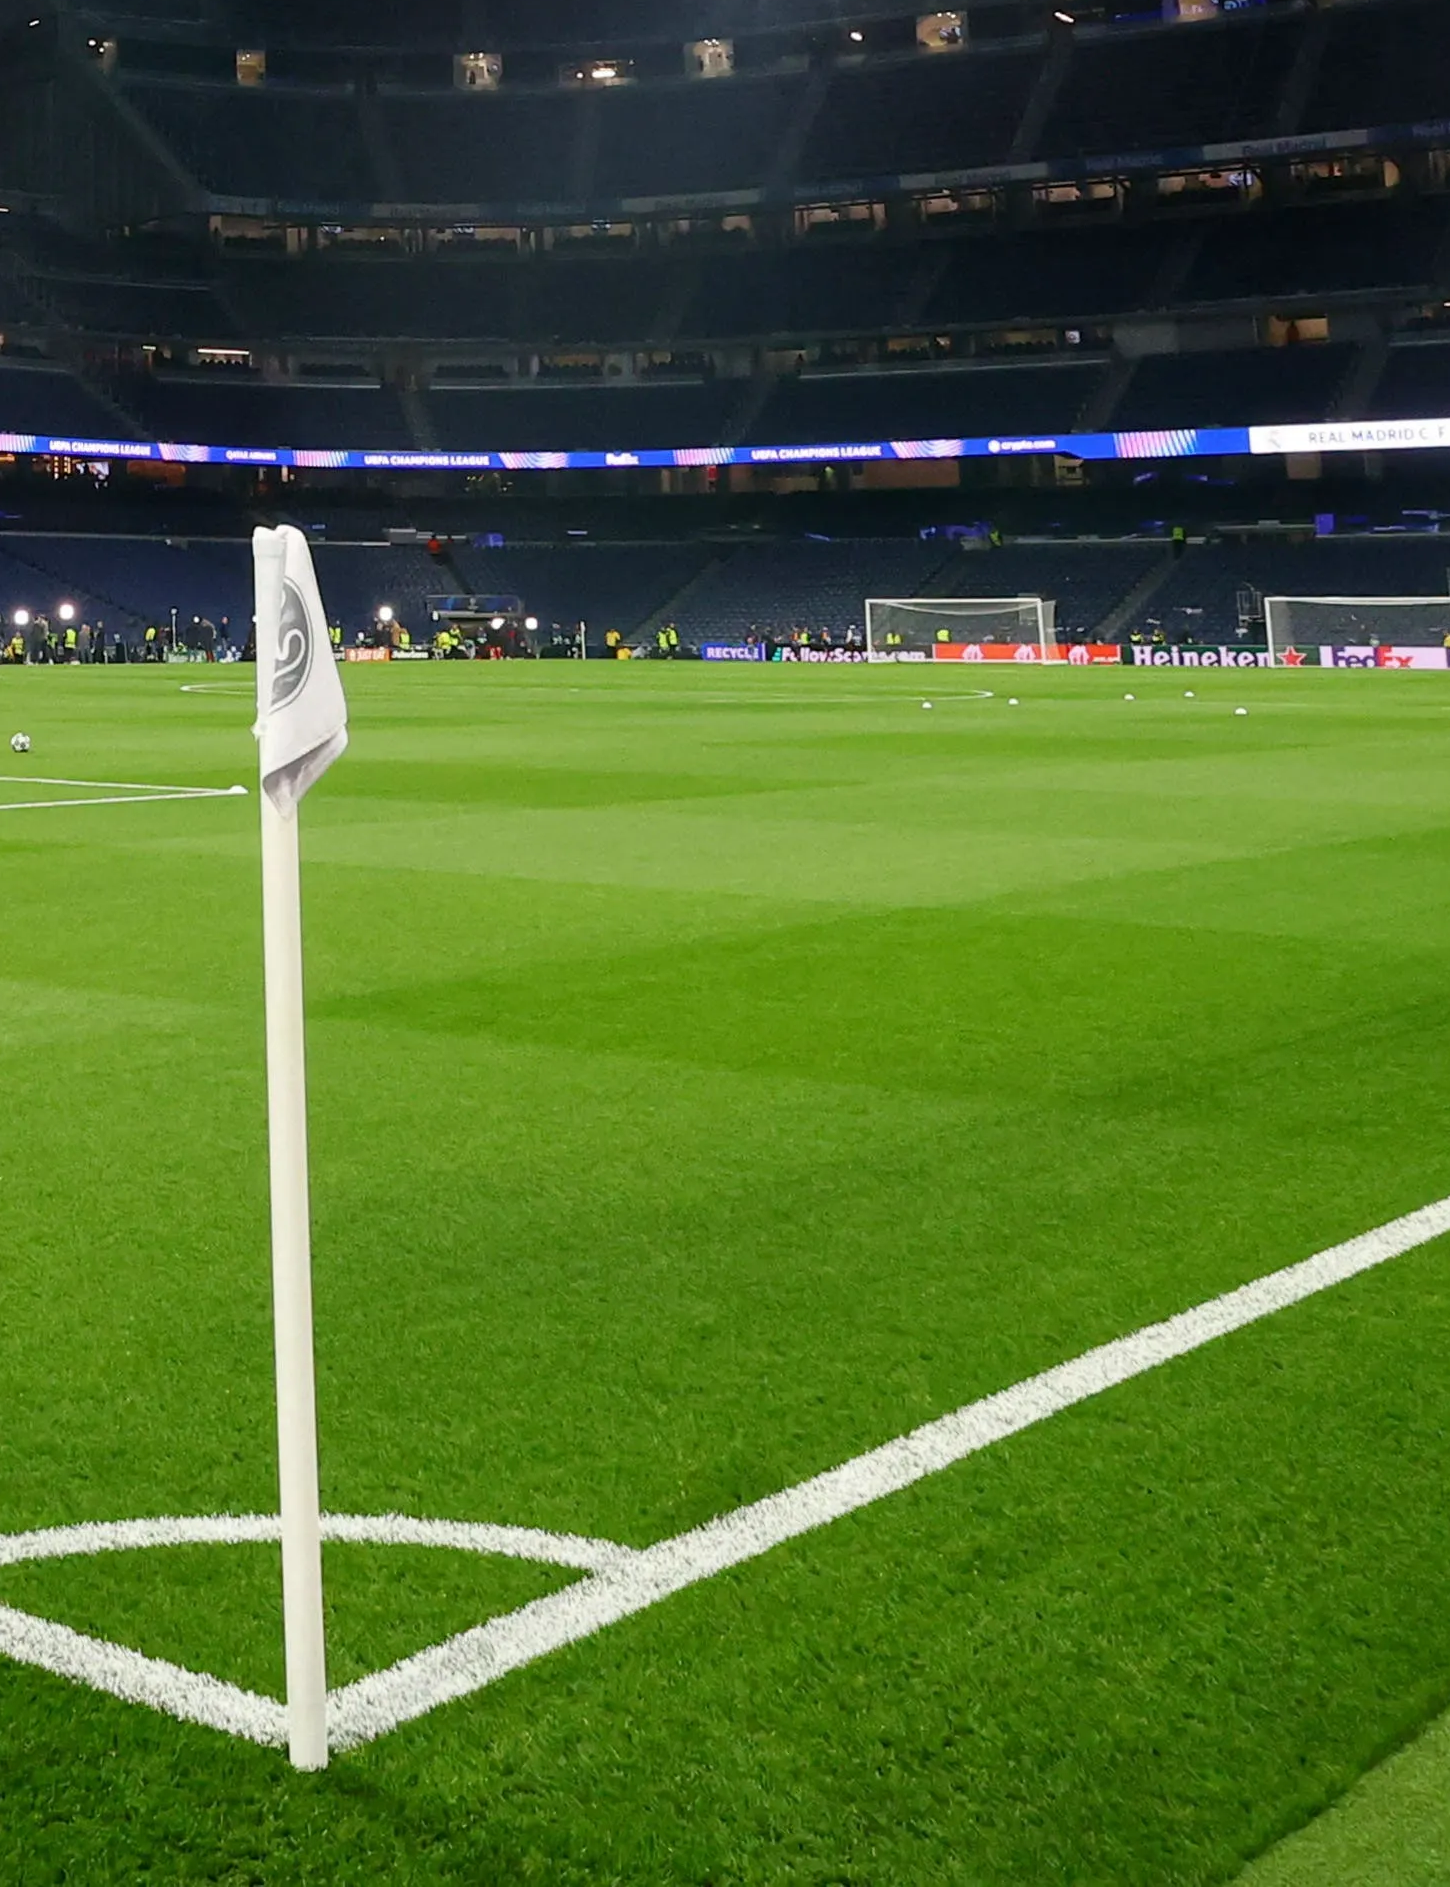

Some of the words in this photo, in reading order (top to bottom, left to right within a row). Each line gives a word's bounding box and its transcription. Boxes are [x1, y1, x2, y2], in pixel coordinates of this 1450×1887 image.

[1308, 430, 1346, 444] REAL
[1351, 427, 1414, 442] MADRID
[49, 440, 71, 453] UEFA
[71, 441, 119, 455] CHAMPIONS
[120, 444, 151, 456] LEAGUE
[751, 449, 779, 461] UEFA
[779, 446, 839, 460] CHAMPIONS
[840, 445, 882, 459] LEAGUE
[363, 454, 389, 466] UEFA
[390, 455, 449, 466] CHAMPIONS
[450, 455, 490, 466] LEAGUE
[1132, 646, 1269, 667] Heineken
[1332, 646, 1413, 668] FedEx
